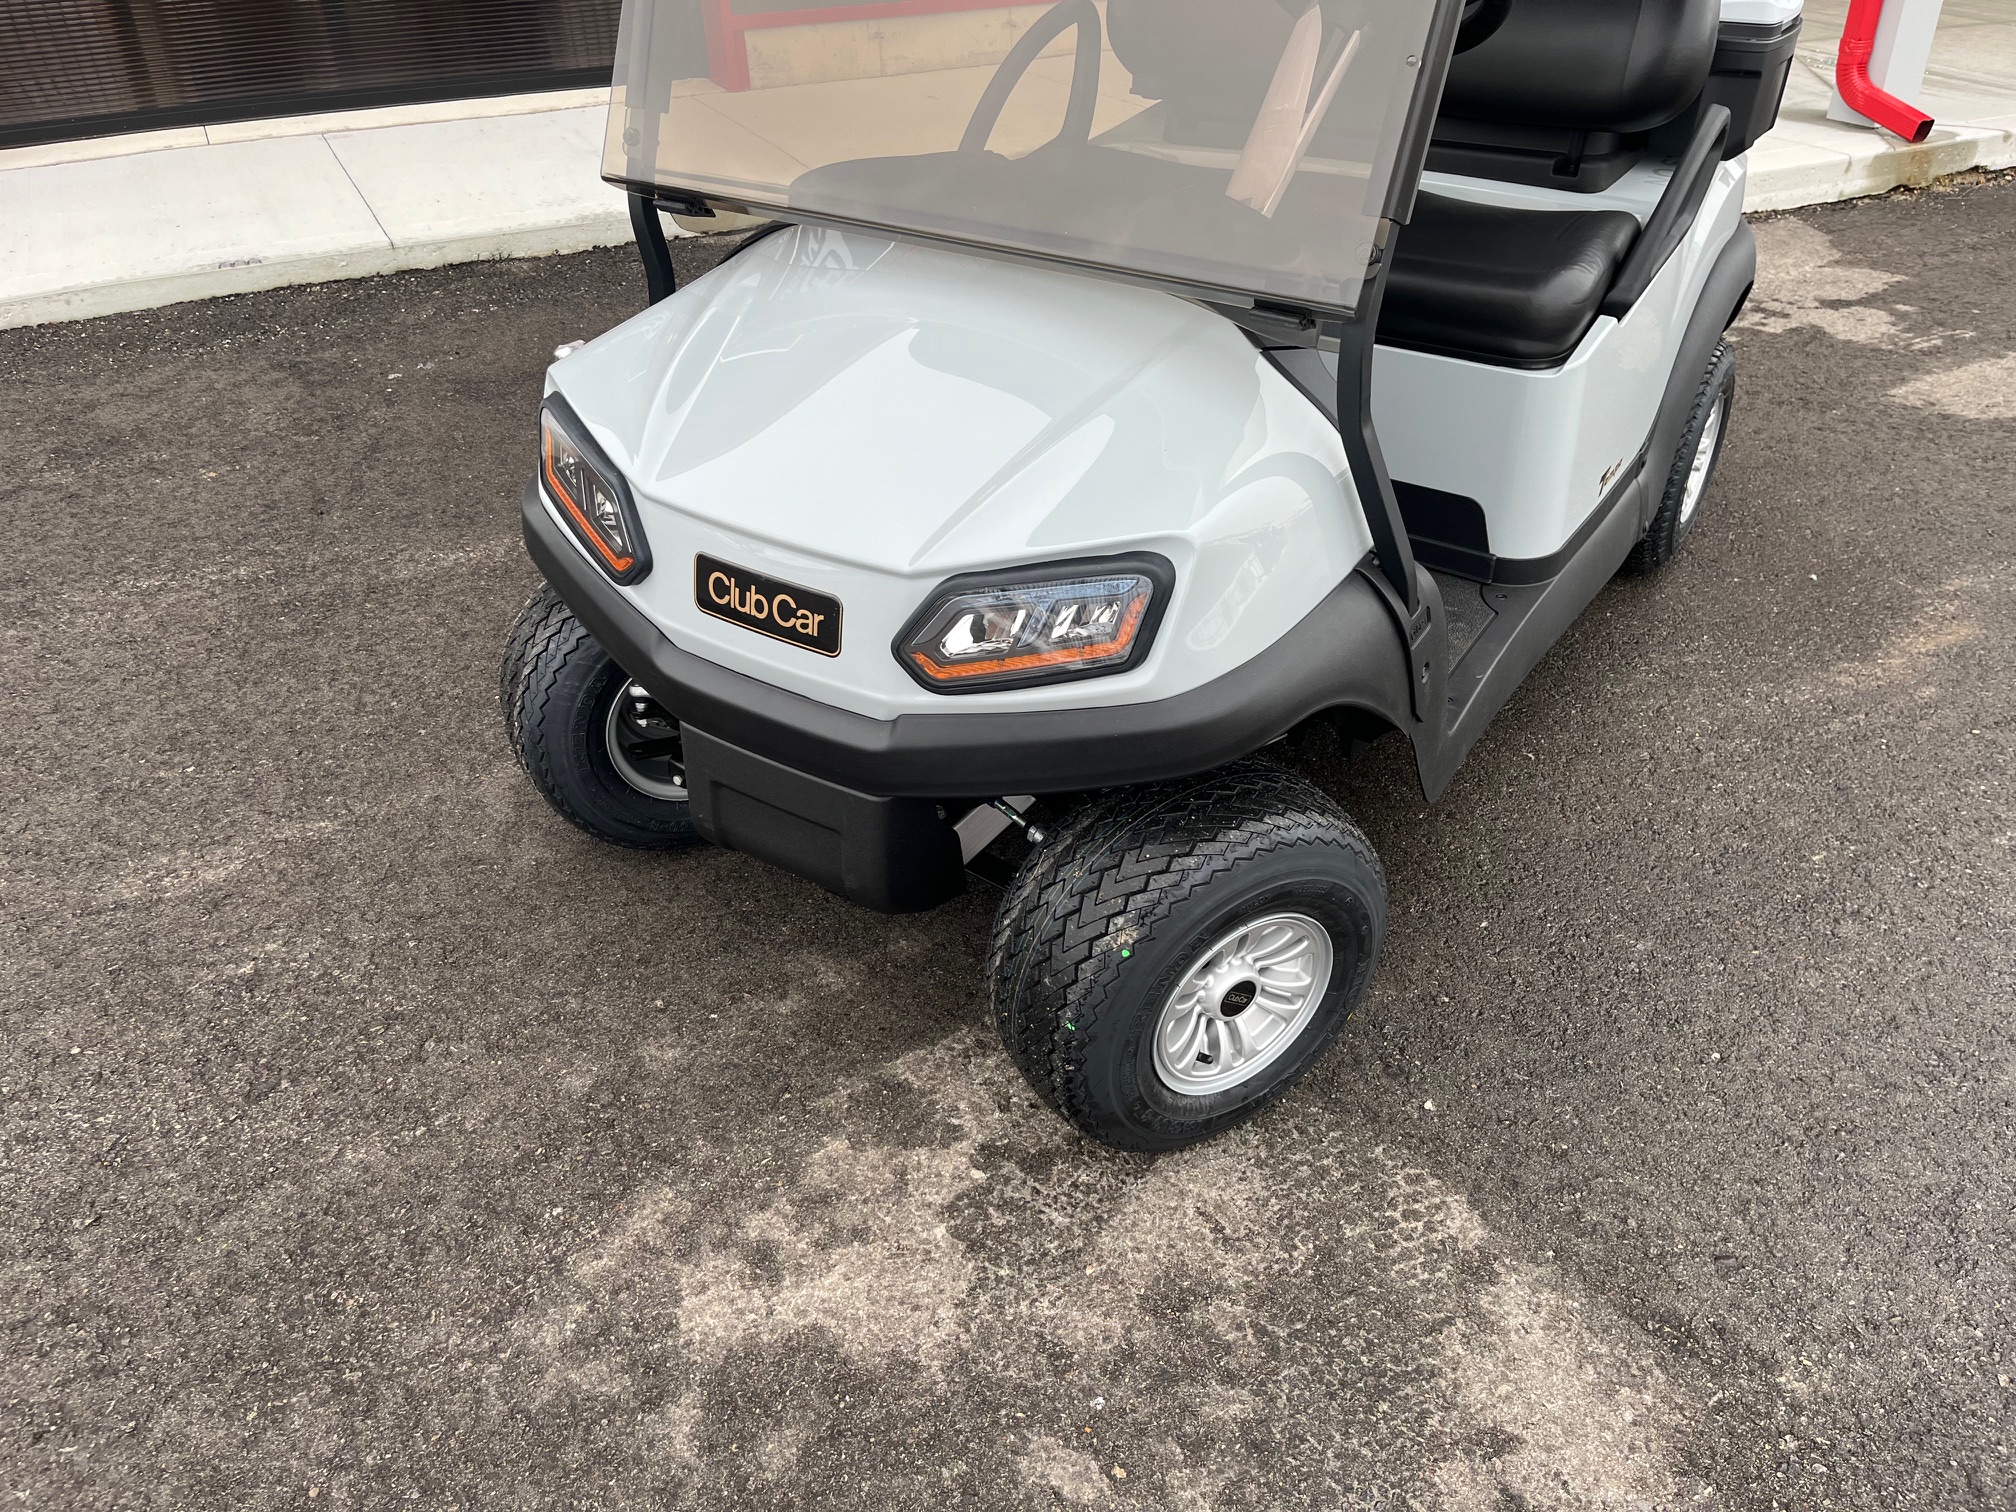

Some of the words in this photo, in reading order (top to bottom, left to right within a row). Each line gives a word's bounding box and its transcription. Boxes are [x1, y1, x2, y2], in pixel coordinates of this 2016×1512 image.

[708, 571, 769, 620] Club
[772, 593, 824, 637] Car
[572, 676, 608, 773] KENDA
[1129, 936, 1209, 1032] KENDA
